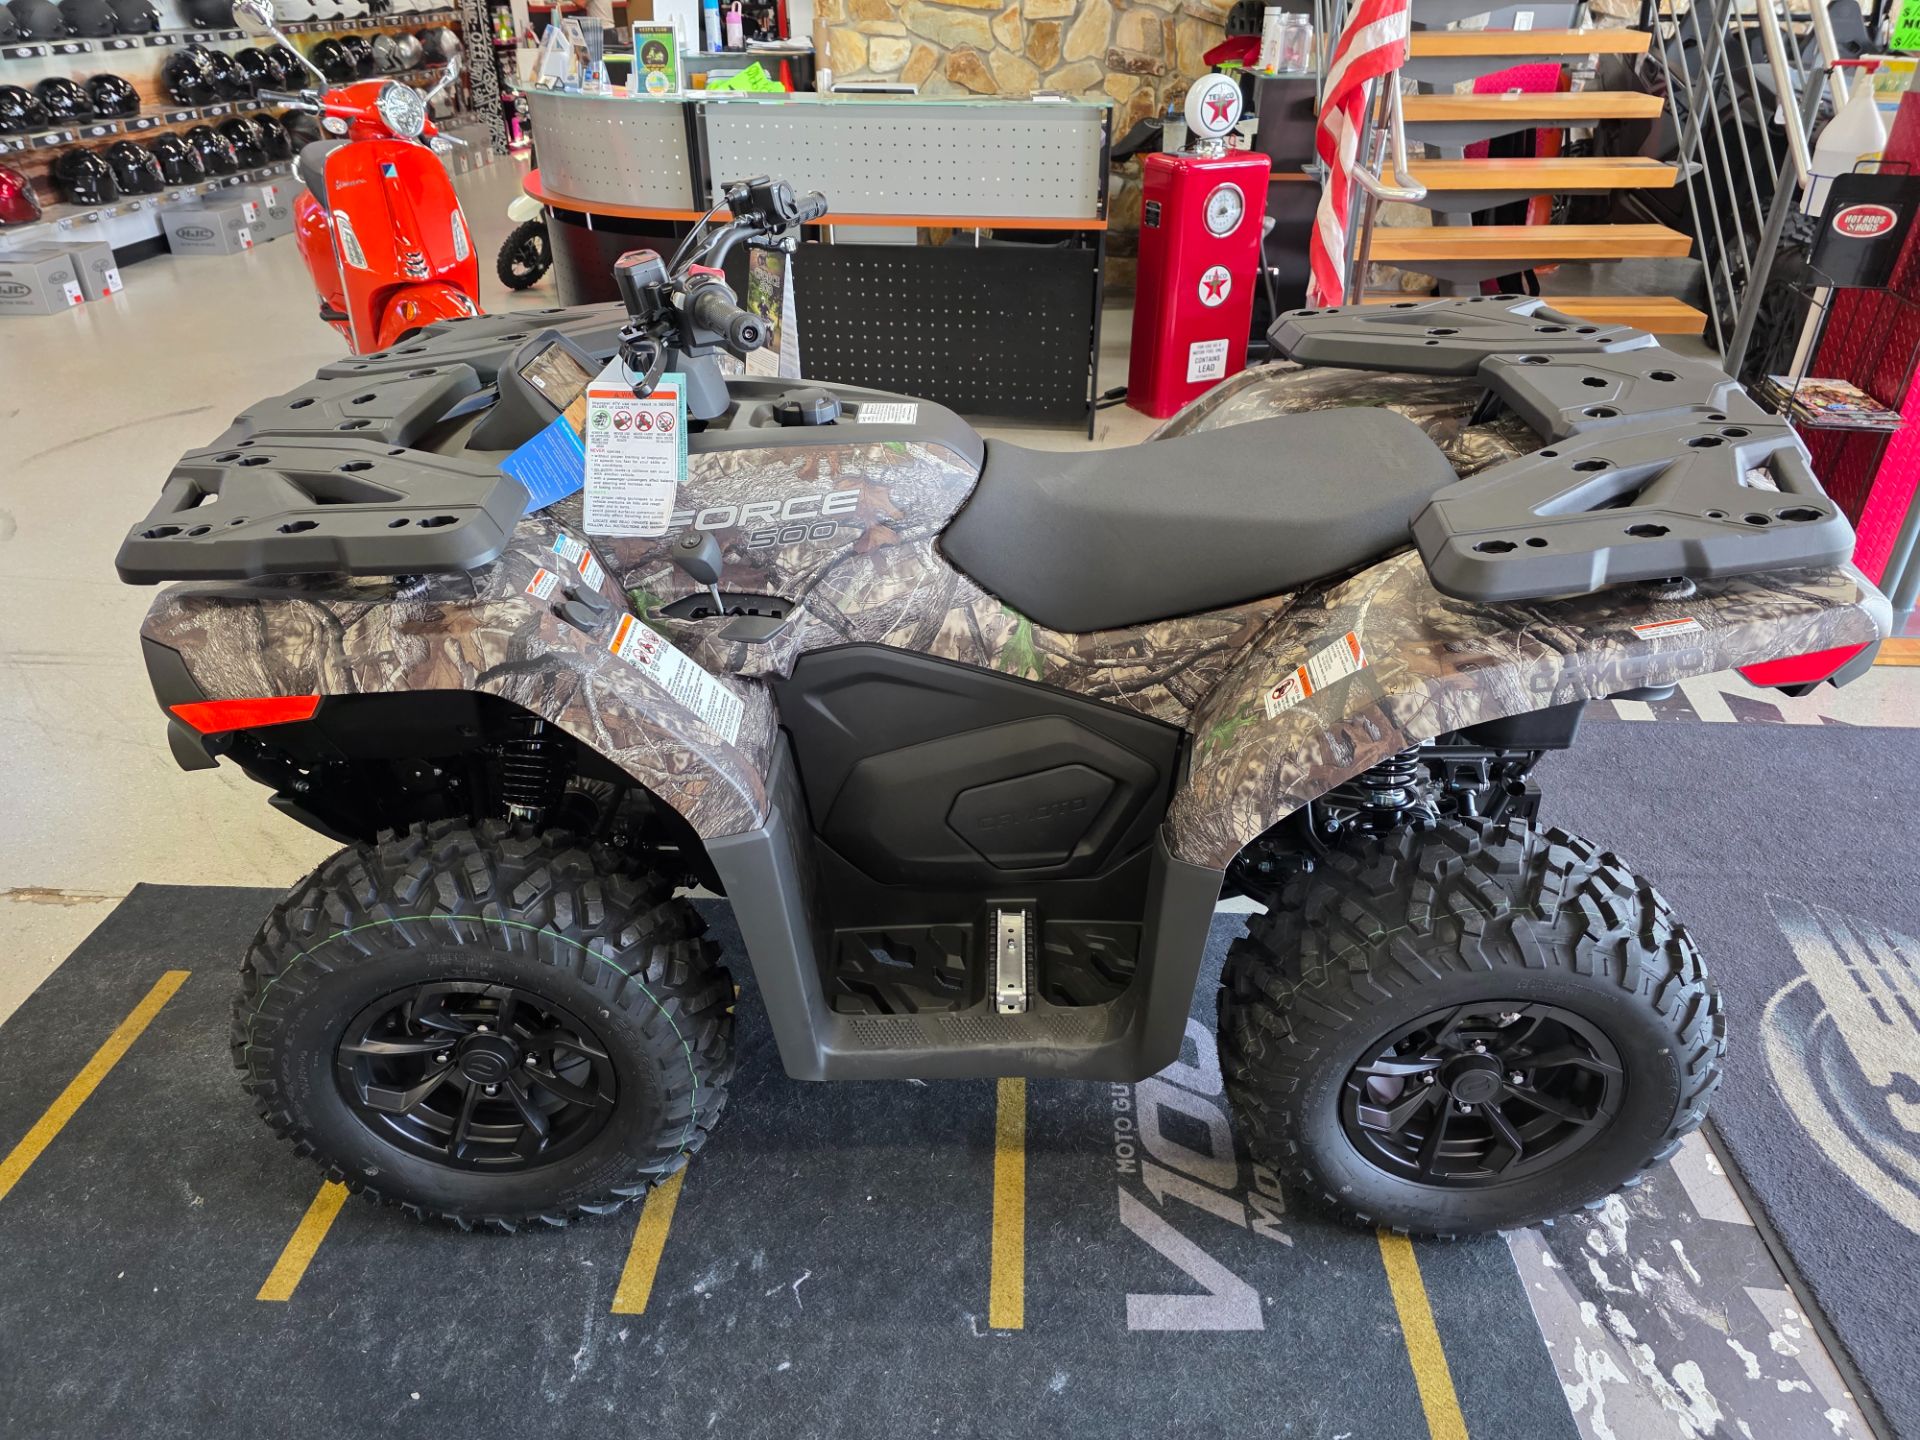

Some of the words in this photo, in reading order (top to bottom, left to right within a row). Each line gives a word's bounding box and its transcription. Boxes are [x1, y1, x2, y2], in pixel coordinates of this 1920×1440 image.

[1844, 214, 1863, 224] HOT
[1862, 214, 1887, 225] RODS
[1854, 223, 1879, 232] HOGS
[180, 230, 209, 239] HJC
[1195, 355, 1220, 364] CONTAINS
[1198, 364, 1216, 373] LEAD
[747, 520, 838, 550] 500
[1113, 1117, 1137, 1173] MOTO
